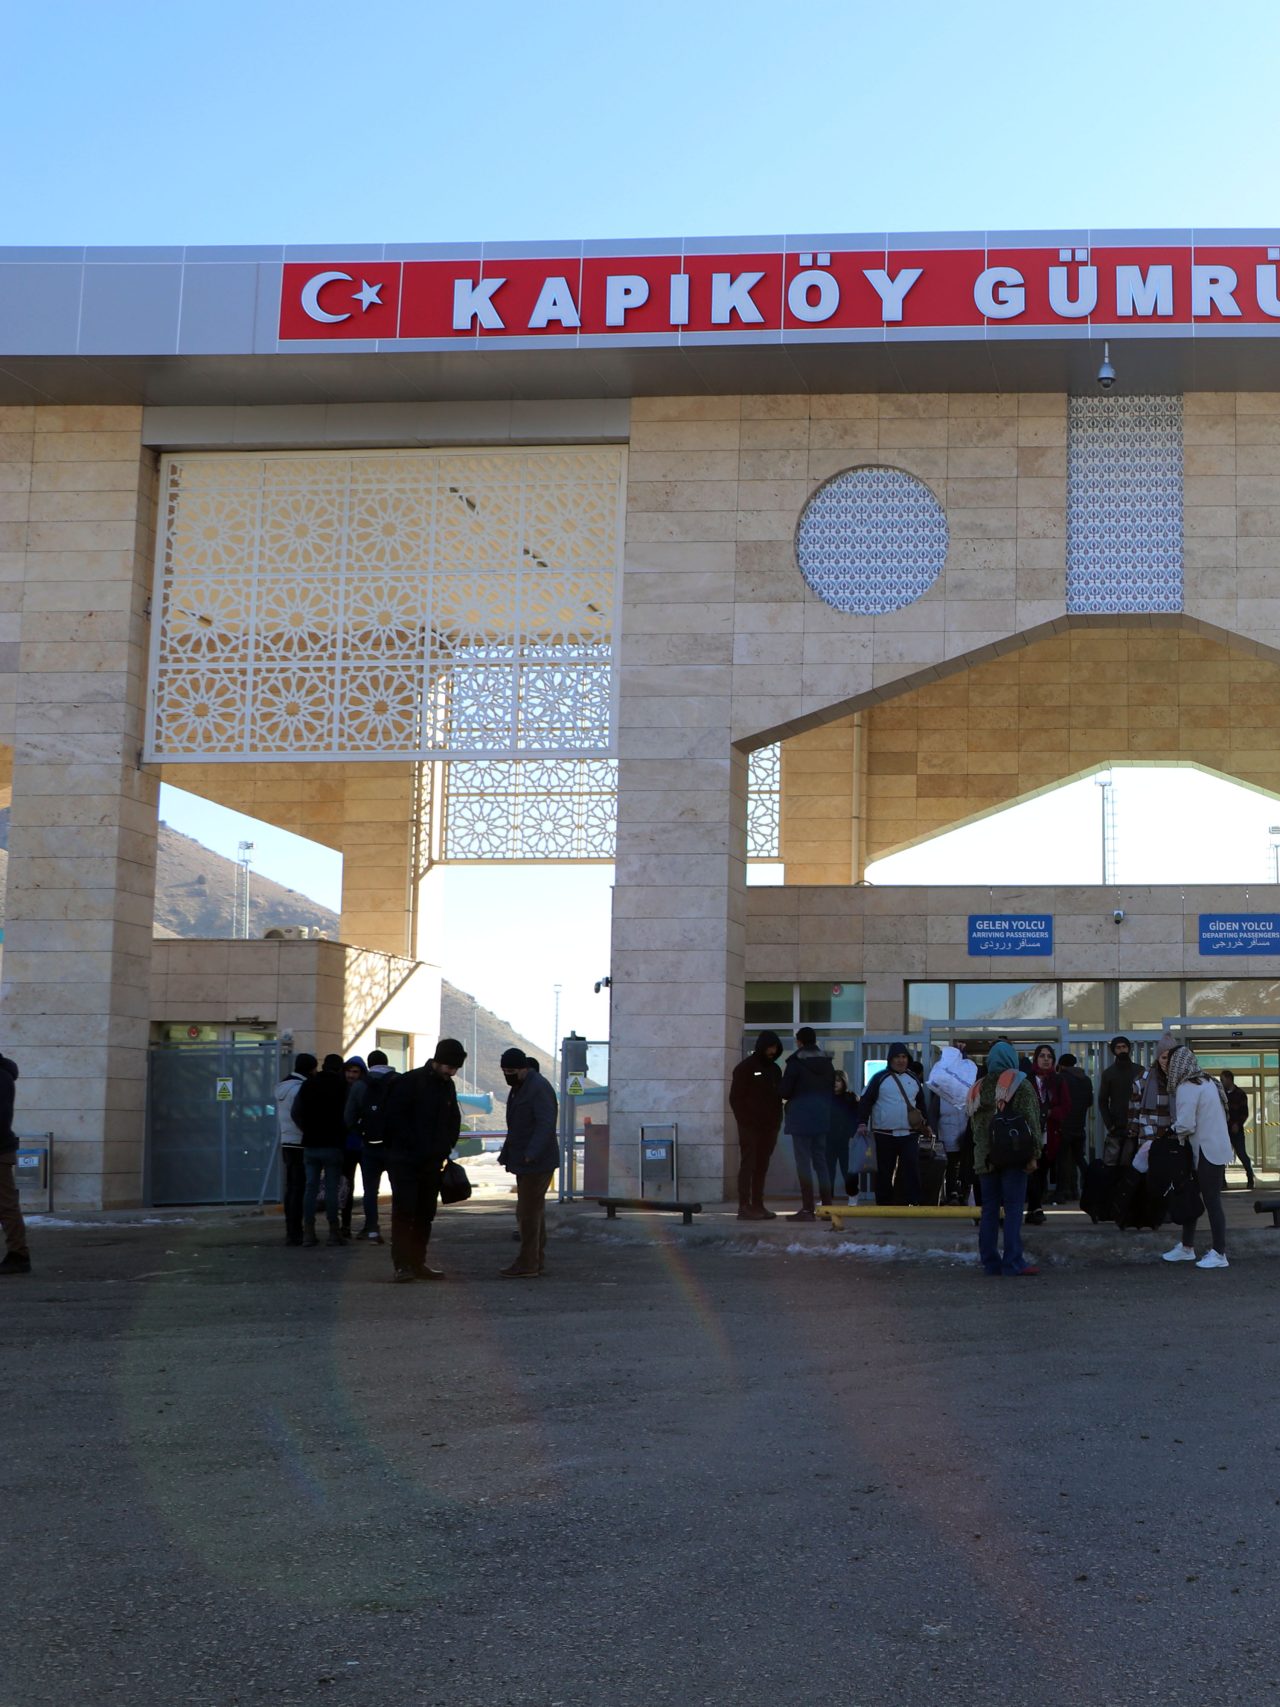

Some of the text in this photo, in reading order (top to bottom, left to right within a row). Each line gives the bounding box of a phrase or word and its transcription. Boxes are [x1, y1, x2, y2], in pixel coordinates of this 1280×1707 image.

[452, 252, 923, 330] KAPIKÖY
[976, 920, 1046, 930] GELEN YOLCU
[1209, 920, 1273, 931] GİDEN YOLCU
[1015, 939, 1041, 950] مسافر
[1247, 938, 1270, 949] مسافر
